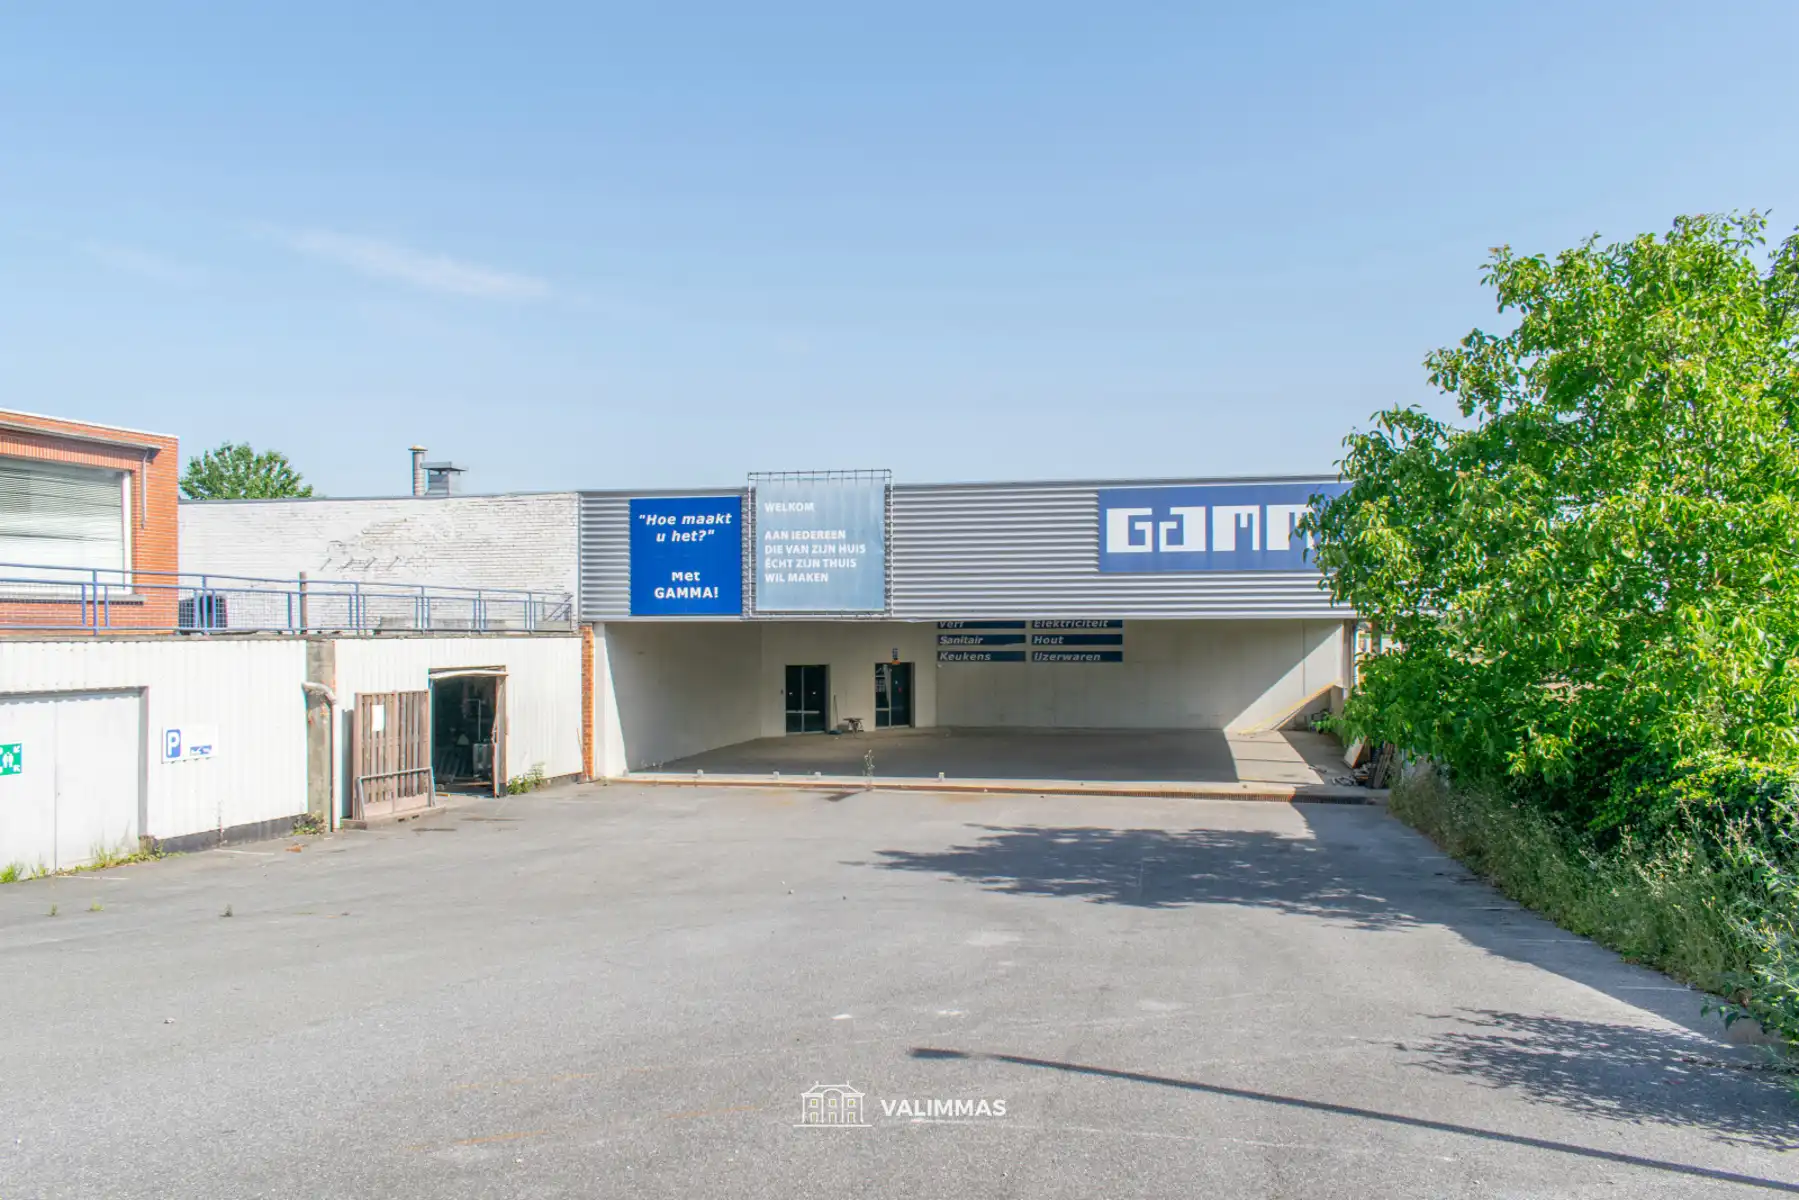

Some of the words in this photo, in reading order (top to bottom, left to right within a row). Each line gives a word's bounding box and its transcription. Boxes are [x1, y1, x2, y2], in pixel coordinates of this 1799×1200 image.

[764, 502, 815, 512] WELKOM
[639, 514, 677, 526] "Hoe
[681, 513, 732, 525] maakt
[656, 533, 666, 542] u
[671, 529, 715, 542] het?"
[764, 530, 788, 540] AAN
[792, 529, 846, 540] IEDEREEN
[764, 544, 783, 554] DIE
[786, 544, 809, 554] VAN
[811, 544, 836, 554] ZIJN
[838, 543, 866, 554] HUIS
[796, 558, 820, 568] ZIJN
[822, 558, 857, 568] THUIS
[671, 571, 700, 582] Met
[764, 573, 786, 583] WIL
[788, 572, 829, 582] MAKEN
[654, 587, 719, 599] GAMMA!
[939, 635, 984, 645] Sanitair
[1034, 635, 1064, 645] Hout
[939, 652, 991, 661] Keukens
[1034, 652, 1101, 661] IJzerwaren
[167, 732, 180, 757] P
